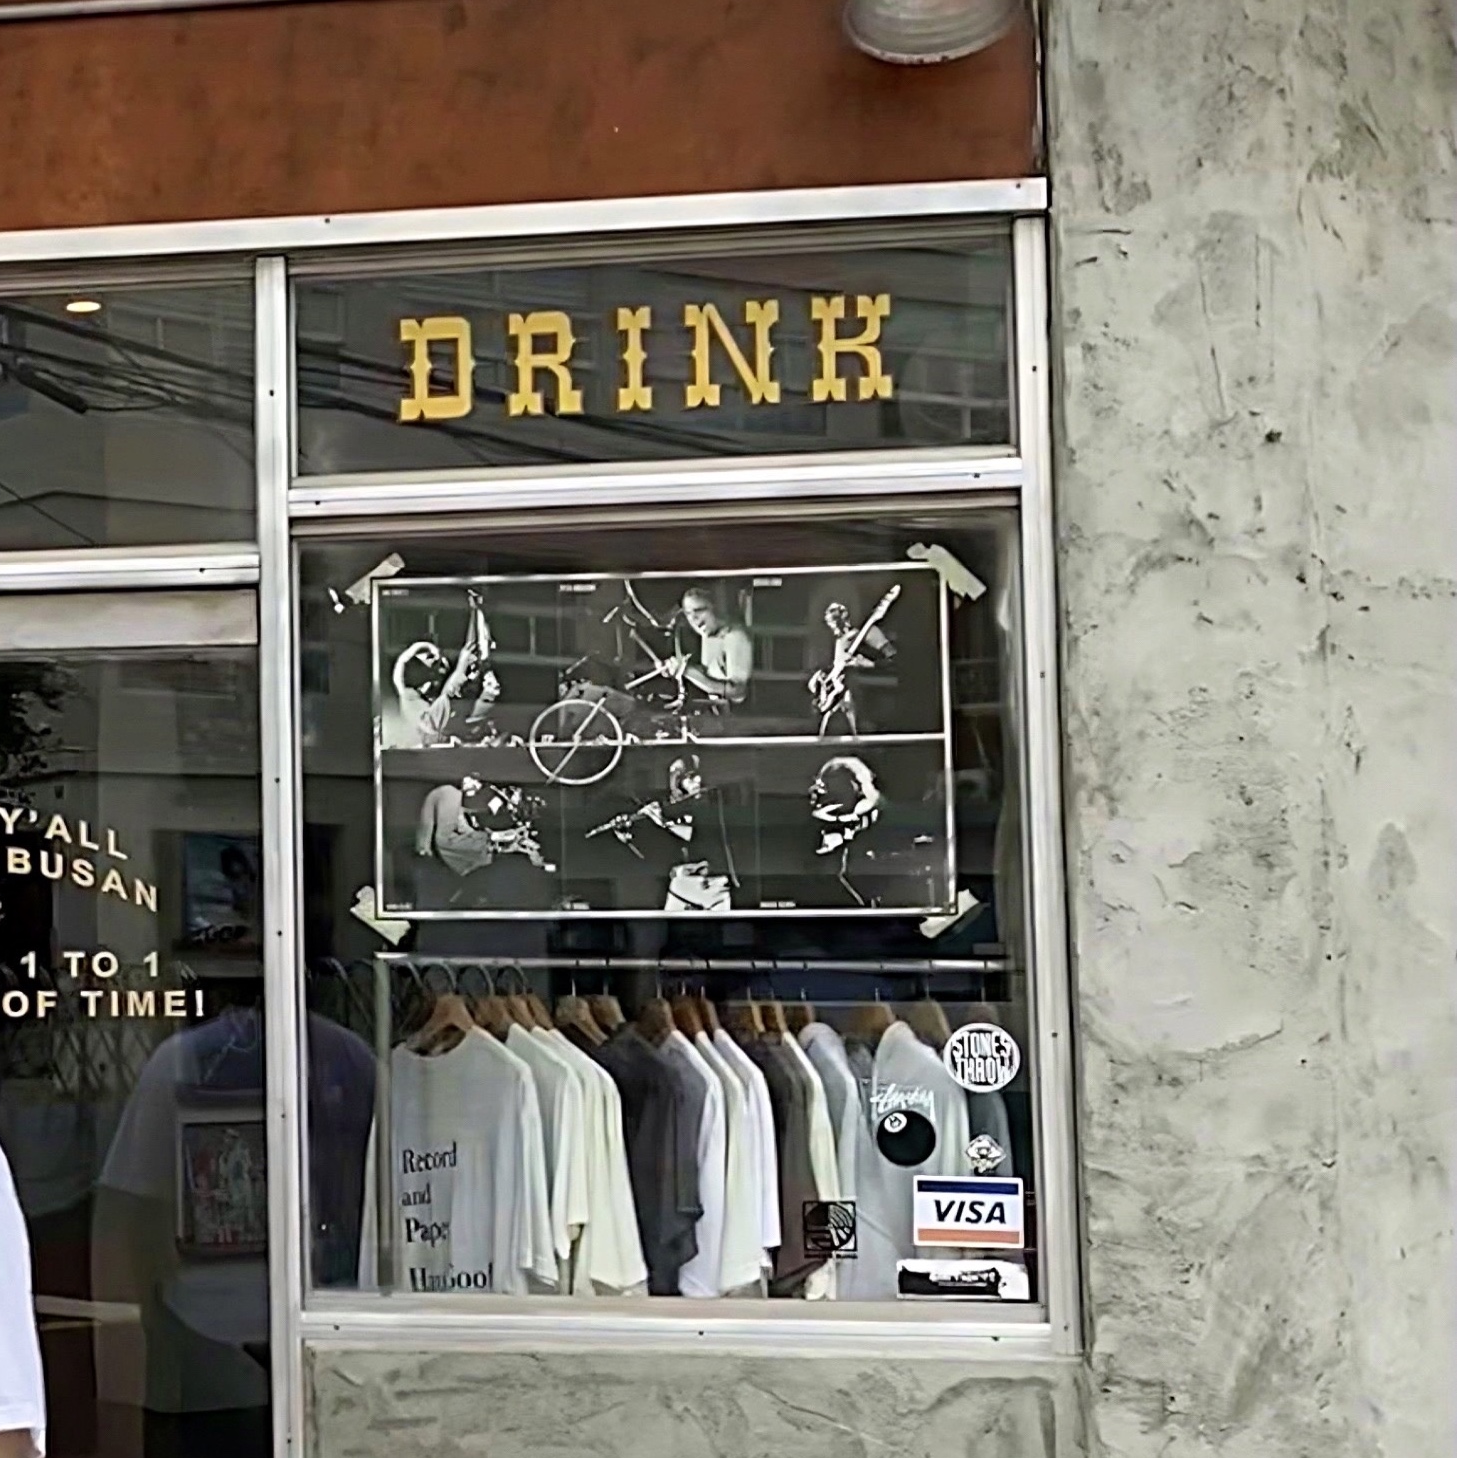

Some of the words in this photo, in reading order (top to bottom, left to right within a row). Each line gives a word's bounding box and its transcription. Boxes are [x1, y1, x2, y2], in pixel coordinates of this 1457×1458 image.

[398, 293, 893, 424] DRINK
[5, 847, 159, 914] BUSAN
[20, 951, 37, 979] 1
[63, 951, 119, 979] TO
[143, 951, 160, 978] 1
[79, 989, 205, 1018] TIME!
[934, 1200, 1007, 1225] VISA
